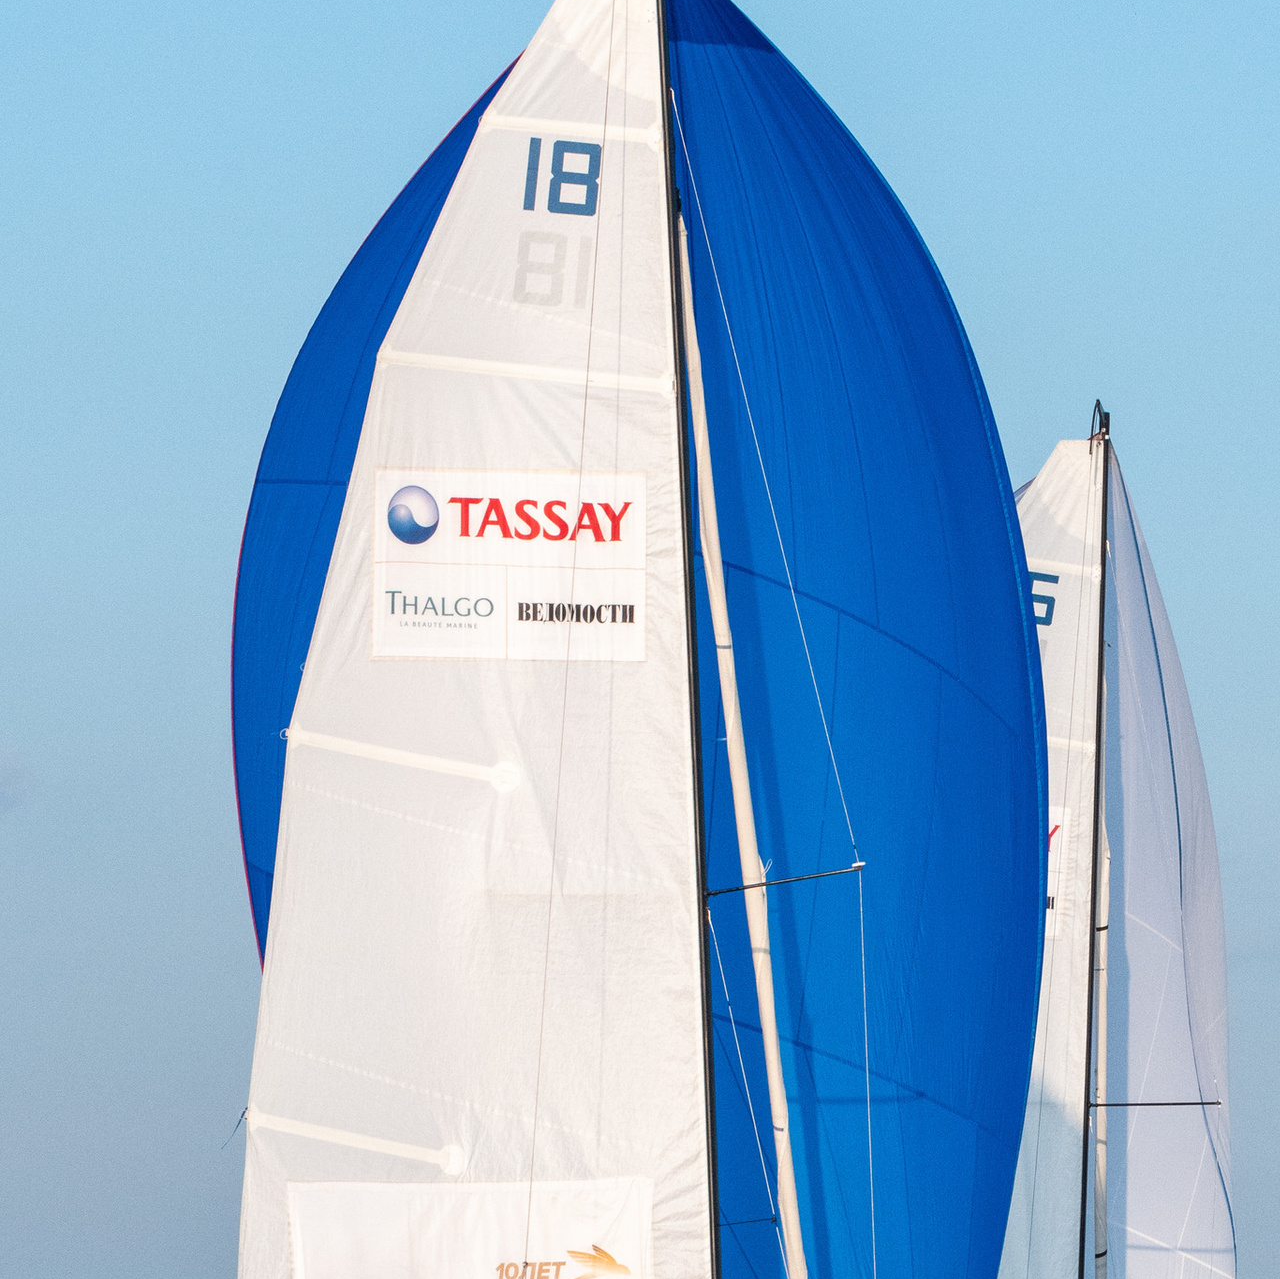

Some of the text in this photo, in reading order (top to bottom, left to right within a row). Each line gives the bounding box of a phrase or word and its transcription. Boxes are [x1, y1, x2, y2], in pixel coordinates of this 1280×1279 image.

[522, 137, 602, 216] 18
[447, 496, 633, 542] TASSAY
[385, 590, 494, 617] THALGO
[517, 602, 635, 624] ВЕДОМОСТИ
